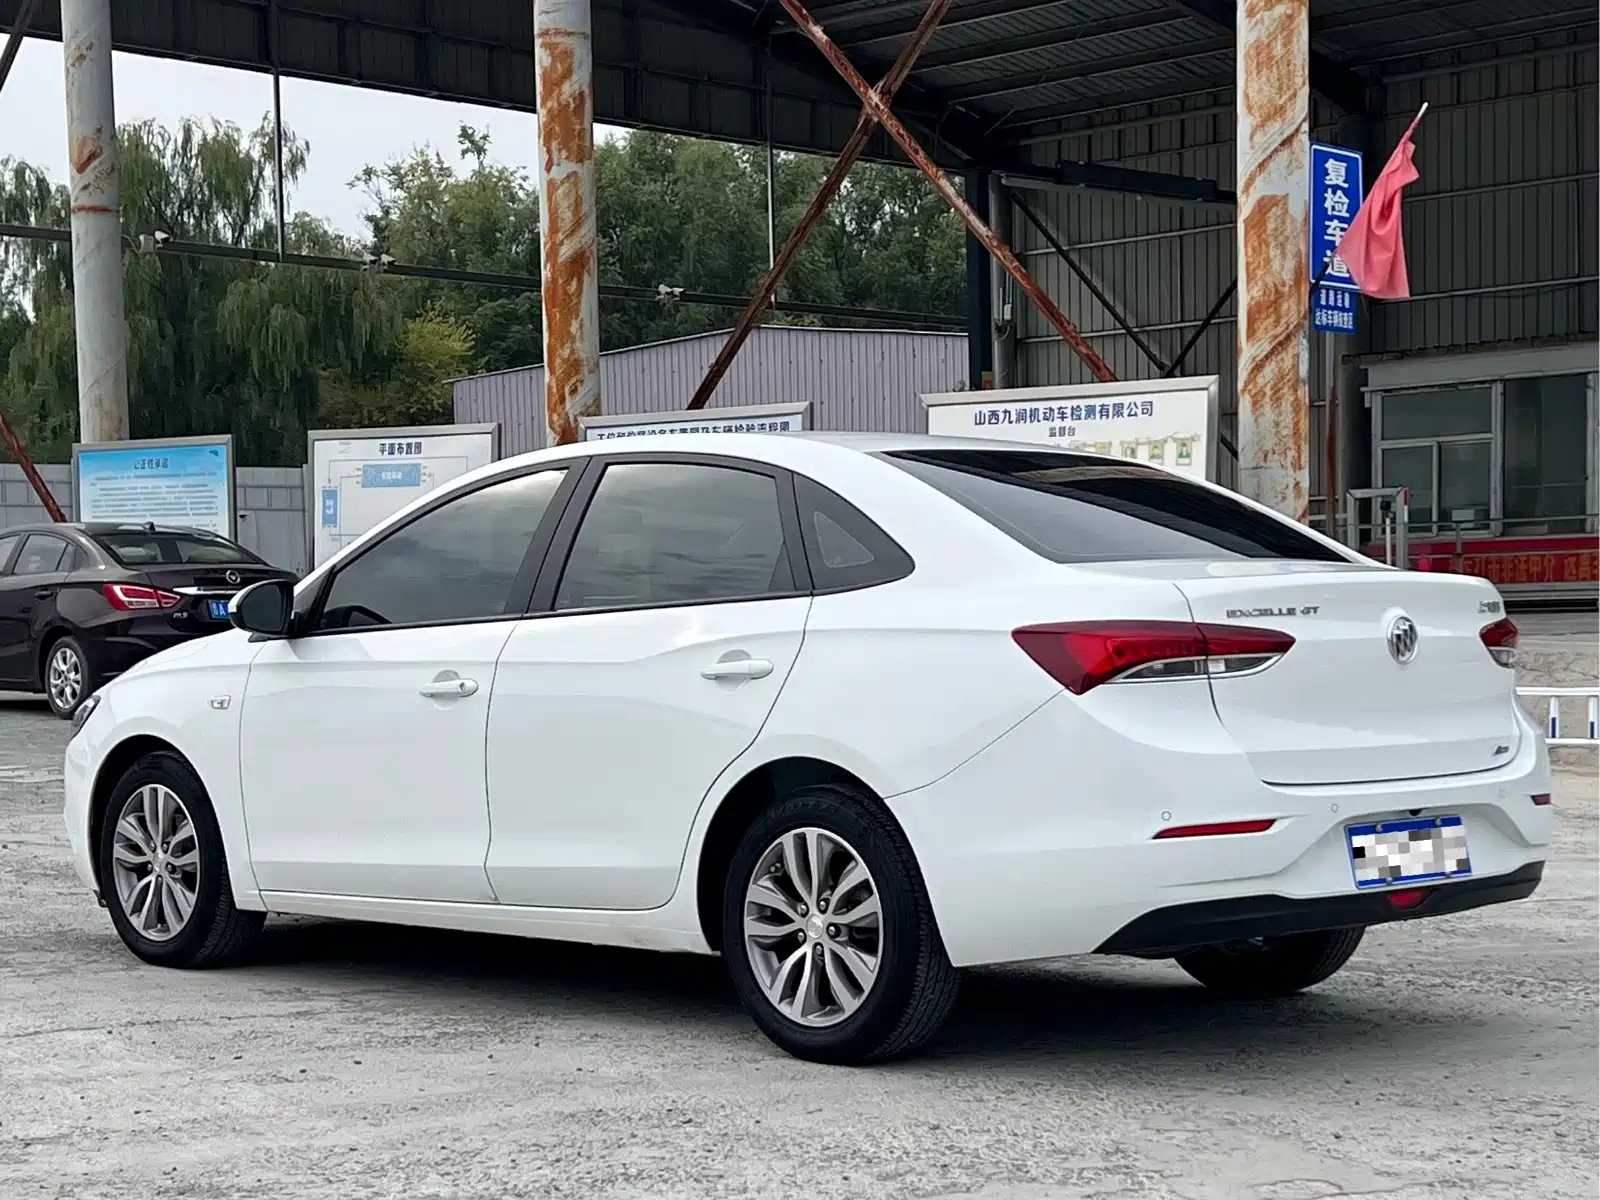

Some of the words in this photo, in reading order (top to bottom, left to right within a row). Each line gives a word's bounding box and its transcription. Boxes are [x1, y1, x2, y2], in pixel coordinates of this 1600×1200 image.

[1323, 158, 1350, 278] 复检车道
[974, 401, 1154, 426] 山西九润机动车检测有限公司
[378, 442, 423, 456] 平面布置图
[1226, 607, 1296, 618] EXCELLE
[1300, 606, 1320, 615] GT
